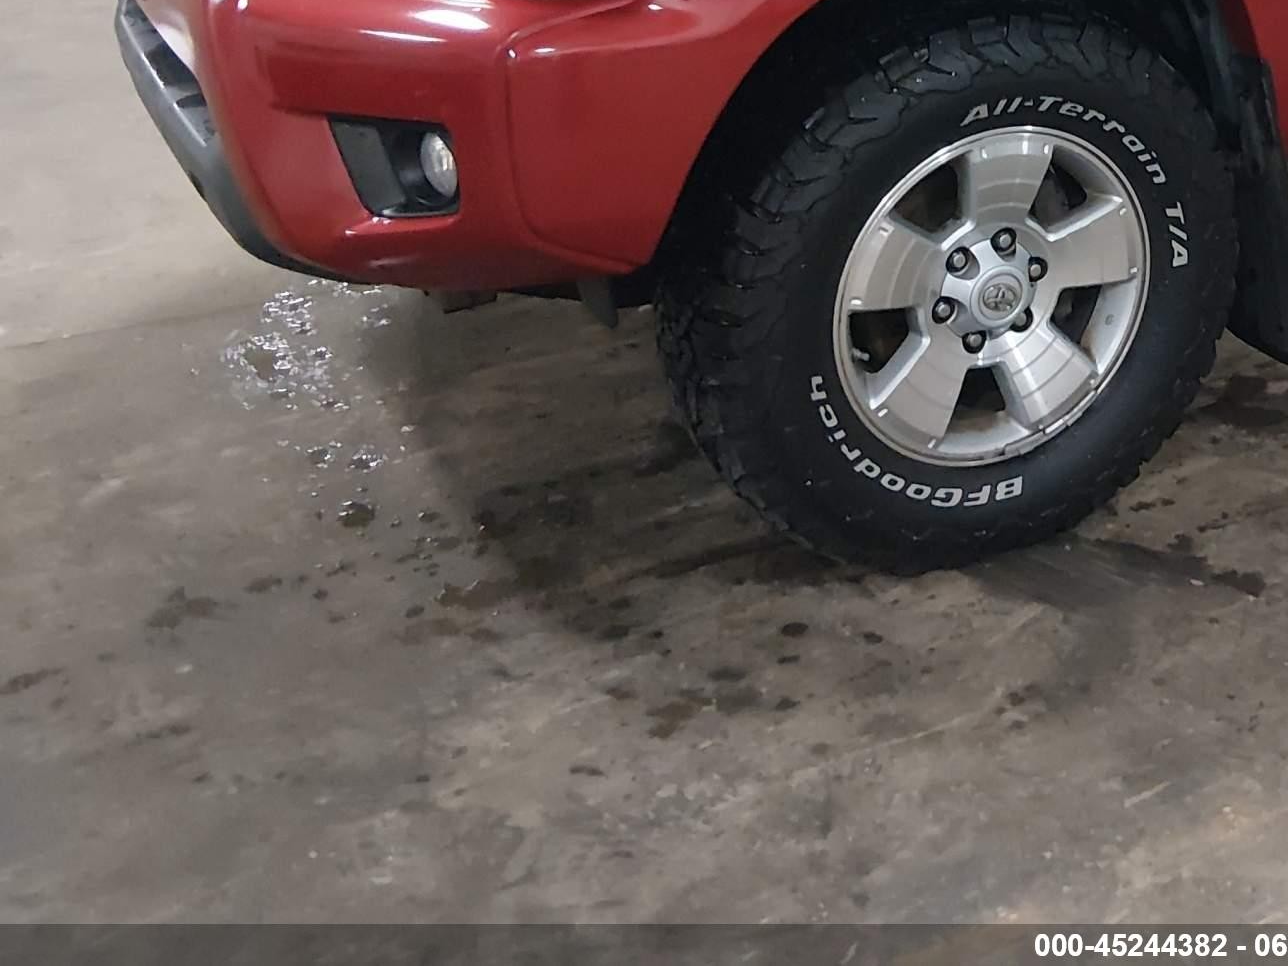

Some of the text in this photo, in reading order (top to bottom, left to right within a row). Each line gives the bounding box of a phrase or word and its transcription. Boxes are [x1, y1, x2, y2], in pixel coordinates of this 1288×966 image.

[960, 95, 1190, 269] All-Terrain T/A
[810, 373, 1023, 508] BFGoodrich
